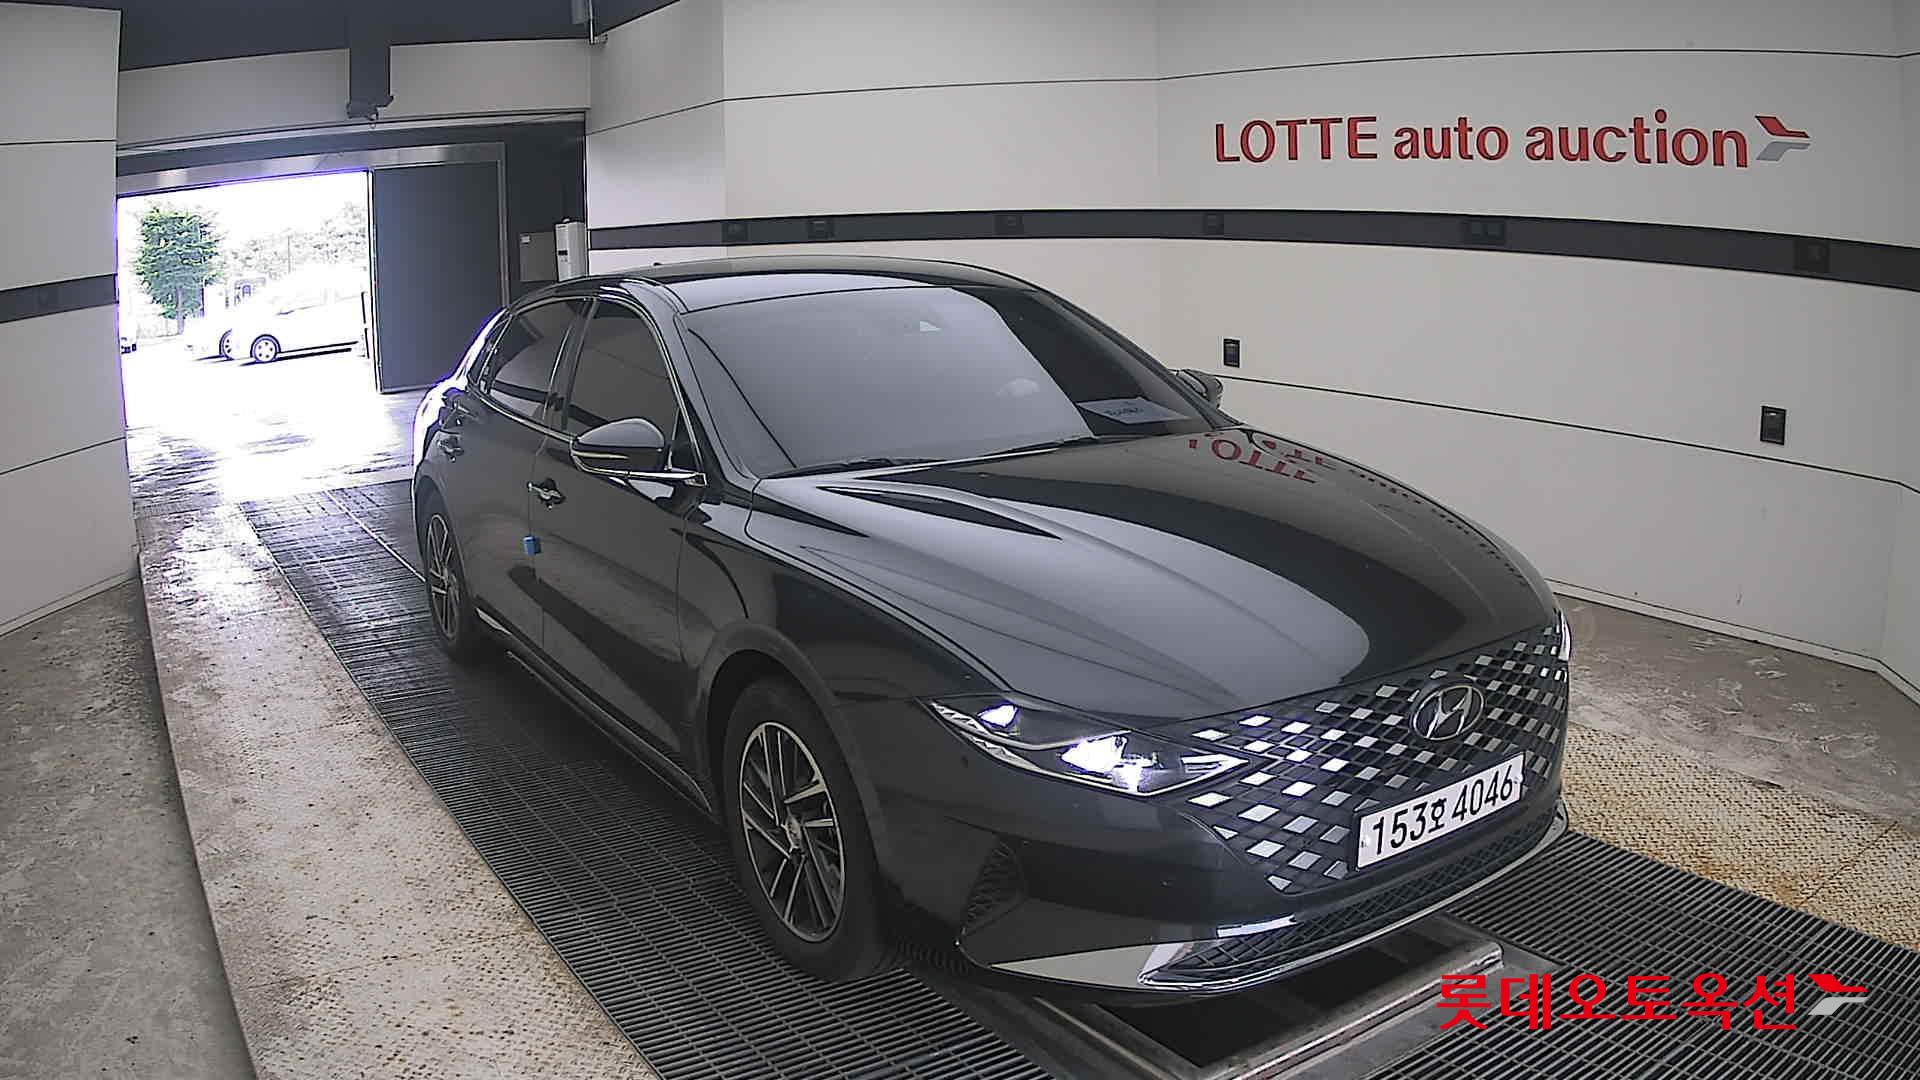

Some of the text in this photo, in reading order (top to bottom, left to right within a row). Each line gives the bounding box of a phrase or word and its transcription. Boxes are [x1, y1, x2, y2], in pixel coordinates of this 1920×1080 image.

[1214, 108, 1749, 169] LOTTE auto auction
[1373, 764, 1514, 856] 153호 4046
